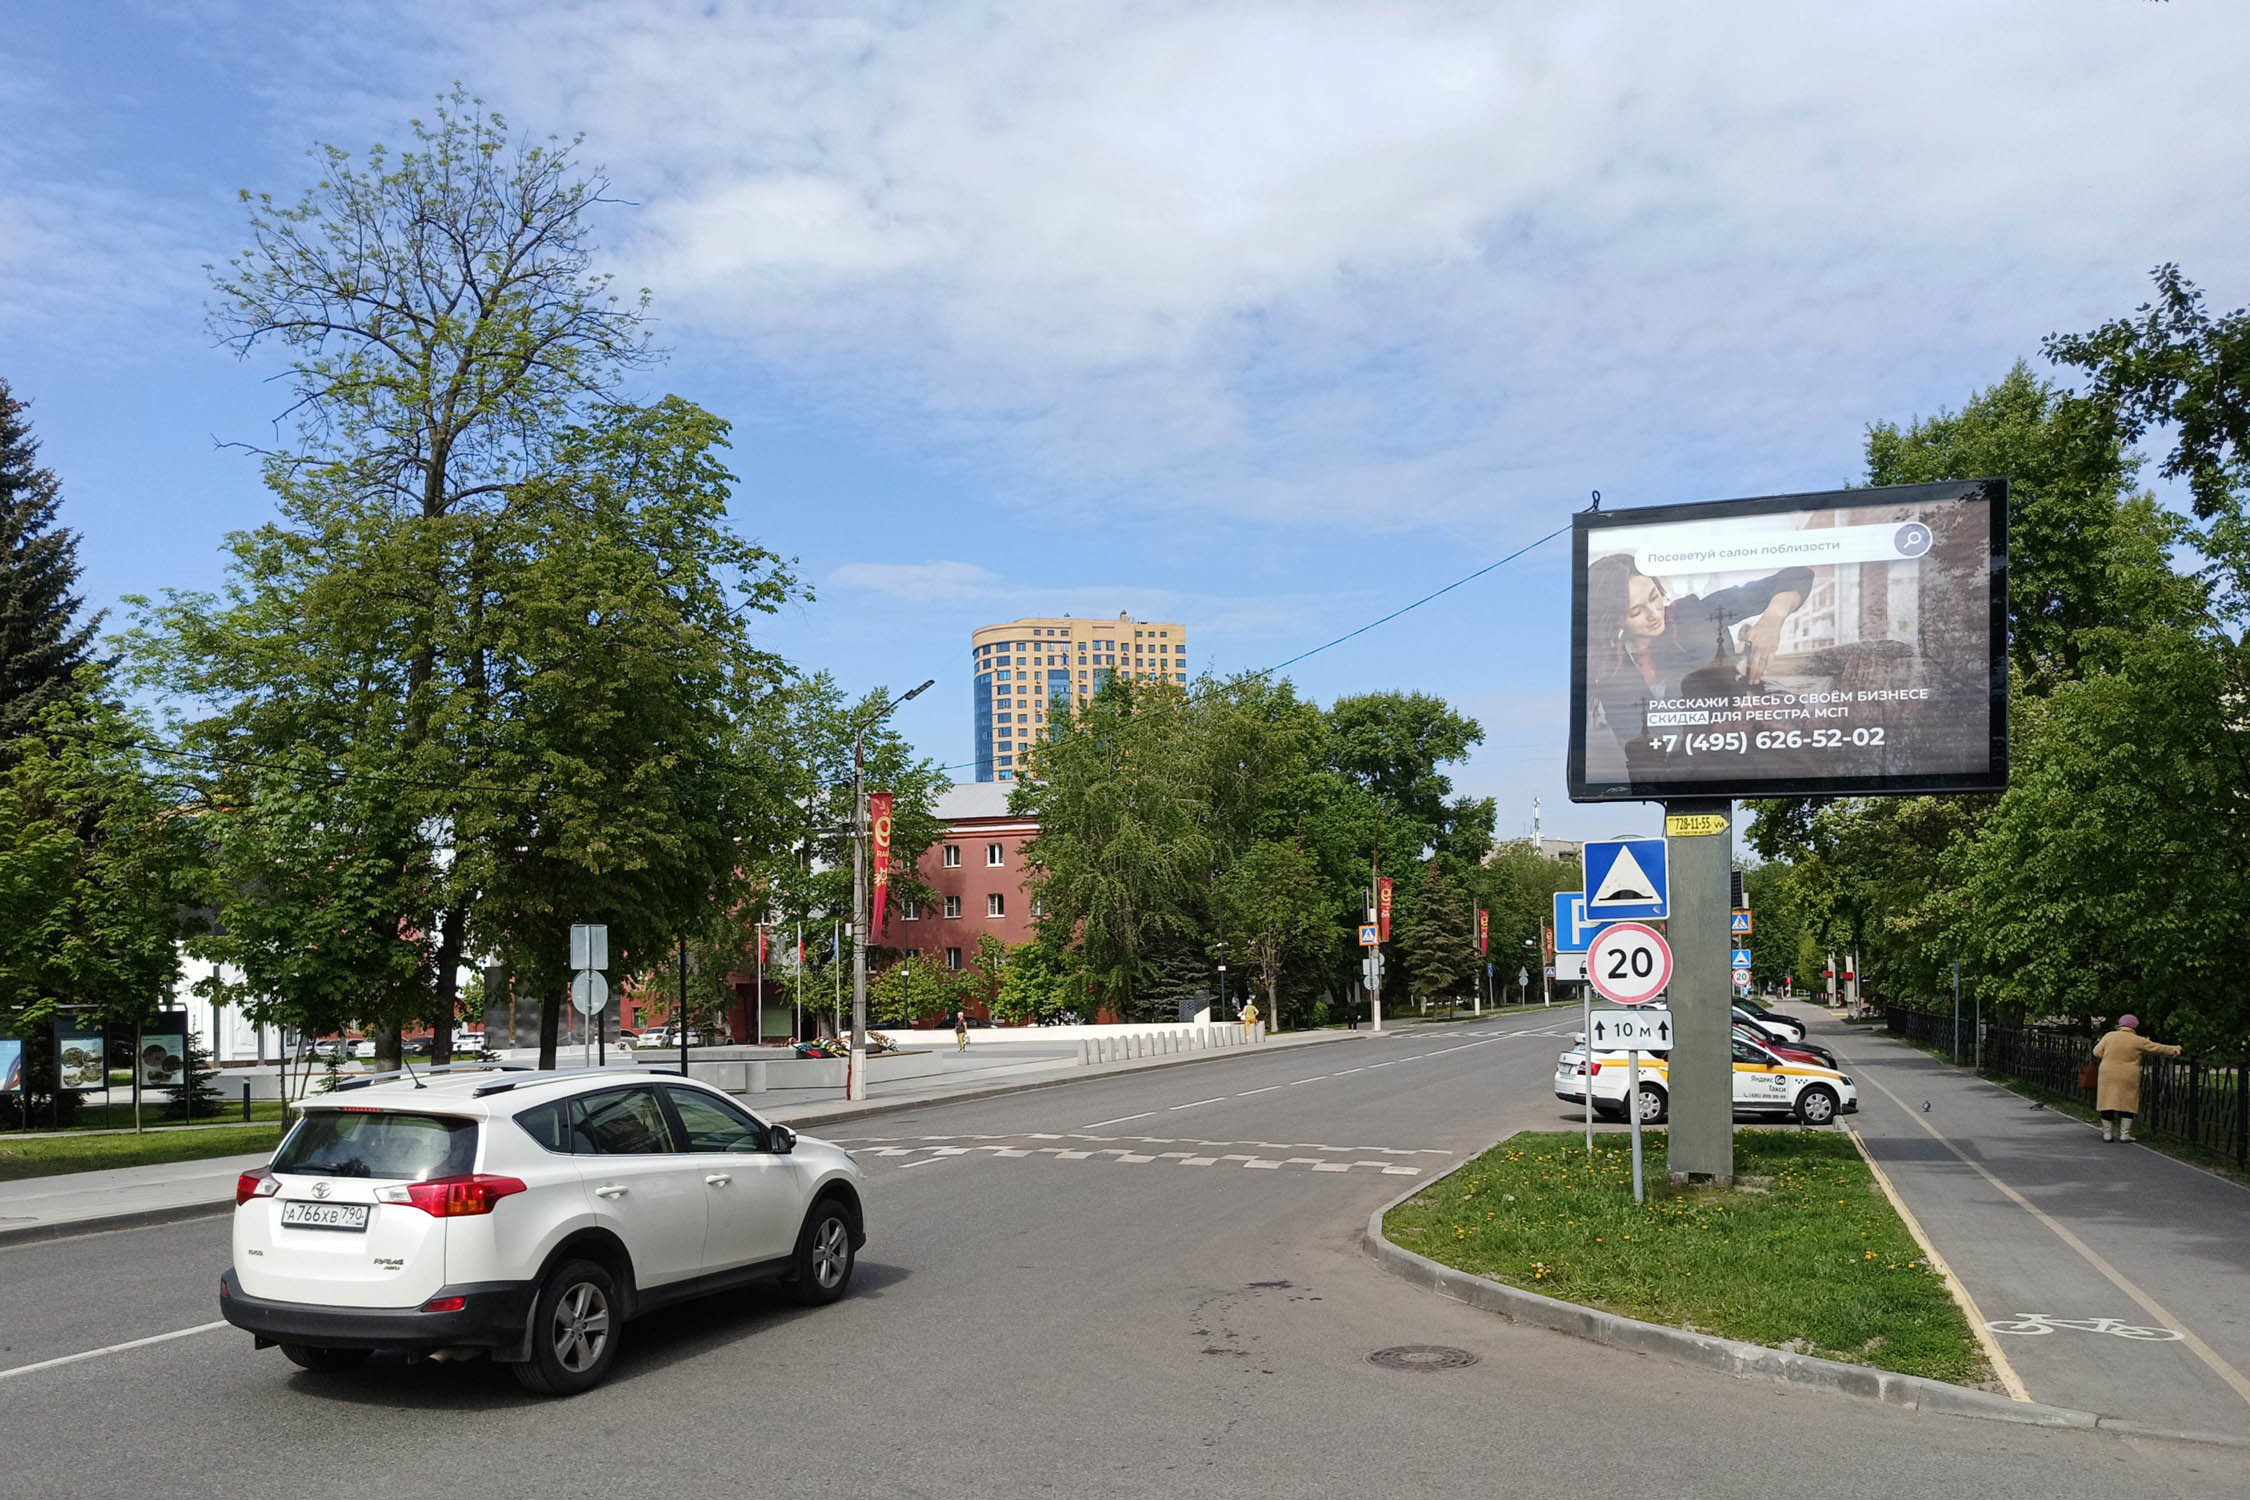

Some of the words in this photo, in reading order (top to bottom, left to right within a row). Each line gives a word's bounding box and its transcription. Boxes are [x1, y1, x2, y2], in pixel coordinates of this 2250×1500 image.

[1648, 549, 1716, 563] Посоветуй
[1719, 547, 1758, 558] салон
[1761, 541, 1841, 555] поблизости
[1649, 697, 1729, 710] РАССКАЖИ
[1732, 695, 1780, 708] ЗДЕСЬ
[1783, 694, 1795, 705] О
[1799, 690, 1853, 704] СВОЁМ
[1857, 688, 1929, 701] БИЗНЕСЕ
[1648, 712, 1707, 725] СКИДКА
[1710, 711, 1741, 724] ДЛЯ
[1746, 708, 1811, 721] РЕЕСТРА
[1814, 707, 1849, 718] МСП
[1649, 734, 1678, 753] +7
[1685, 731, 1748, 756] (495)
[1755, 727, 1885, 749] 626-52-02
[1607, 947, 1653, 979] 20
[1736, 973, 1747, 981] 20
[1614, 1023, 1633, 1037] 10
[342, 1207, 362, 1220] 790
